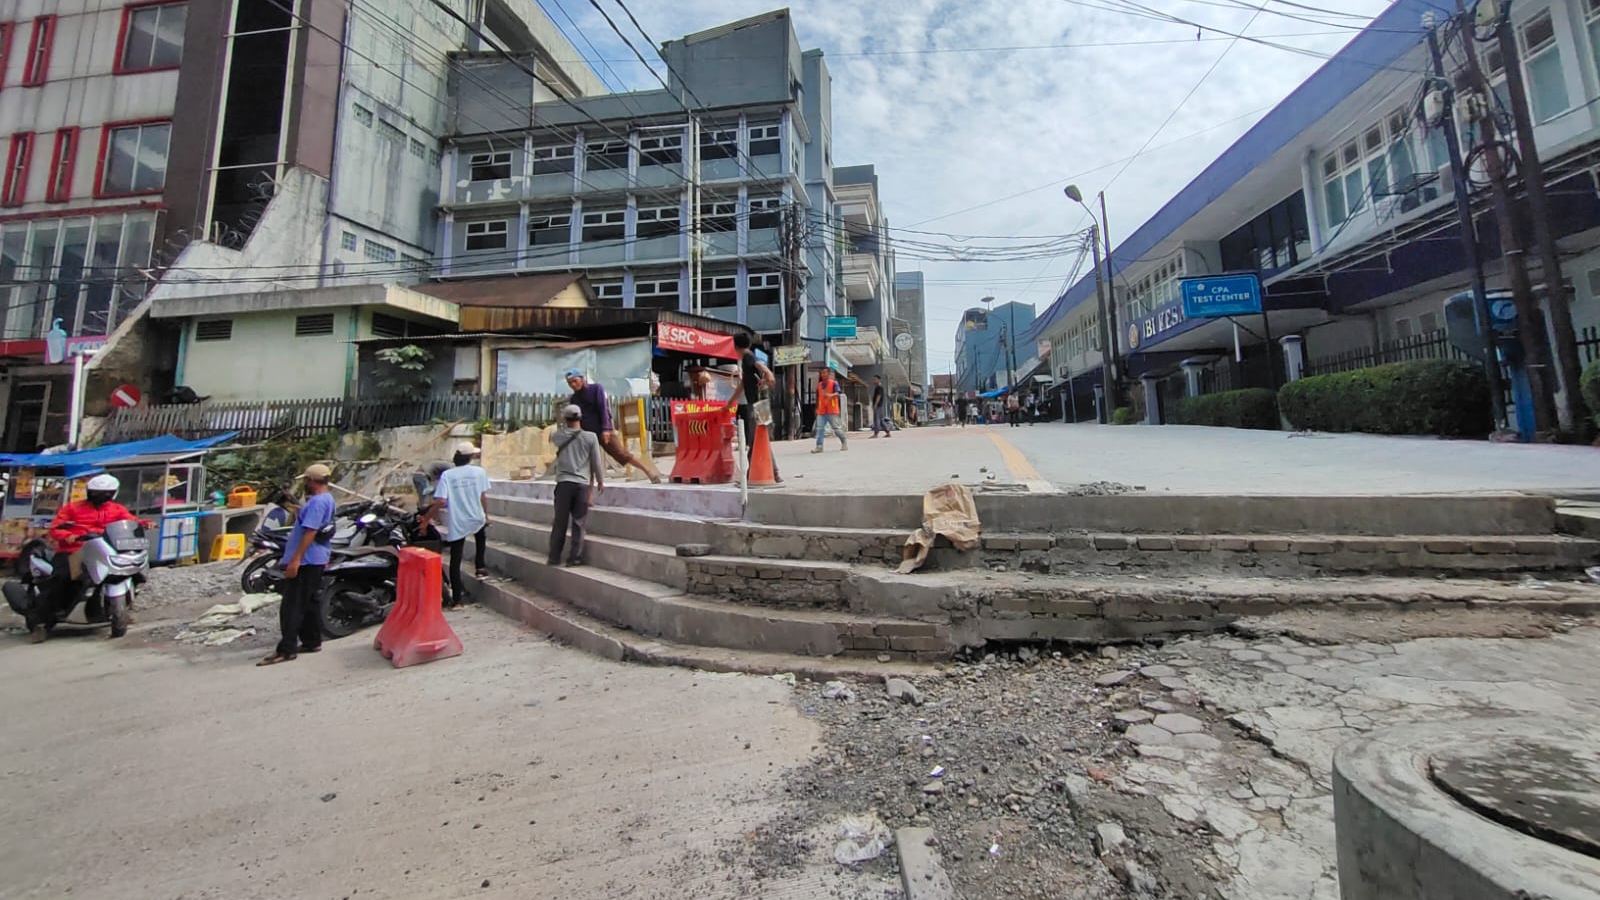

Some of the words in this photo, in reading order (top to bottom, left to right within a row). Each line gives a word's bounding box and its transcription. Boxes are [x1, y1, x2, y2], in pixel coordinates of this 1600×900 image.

[1211, 286, 1230, 294] CPA
[1192, 295, 1213, 304] TEST
[1215, 292, 1250, 302] CENTER
[670, 327, 696, 345] SRC
